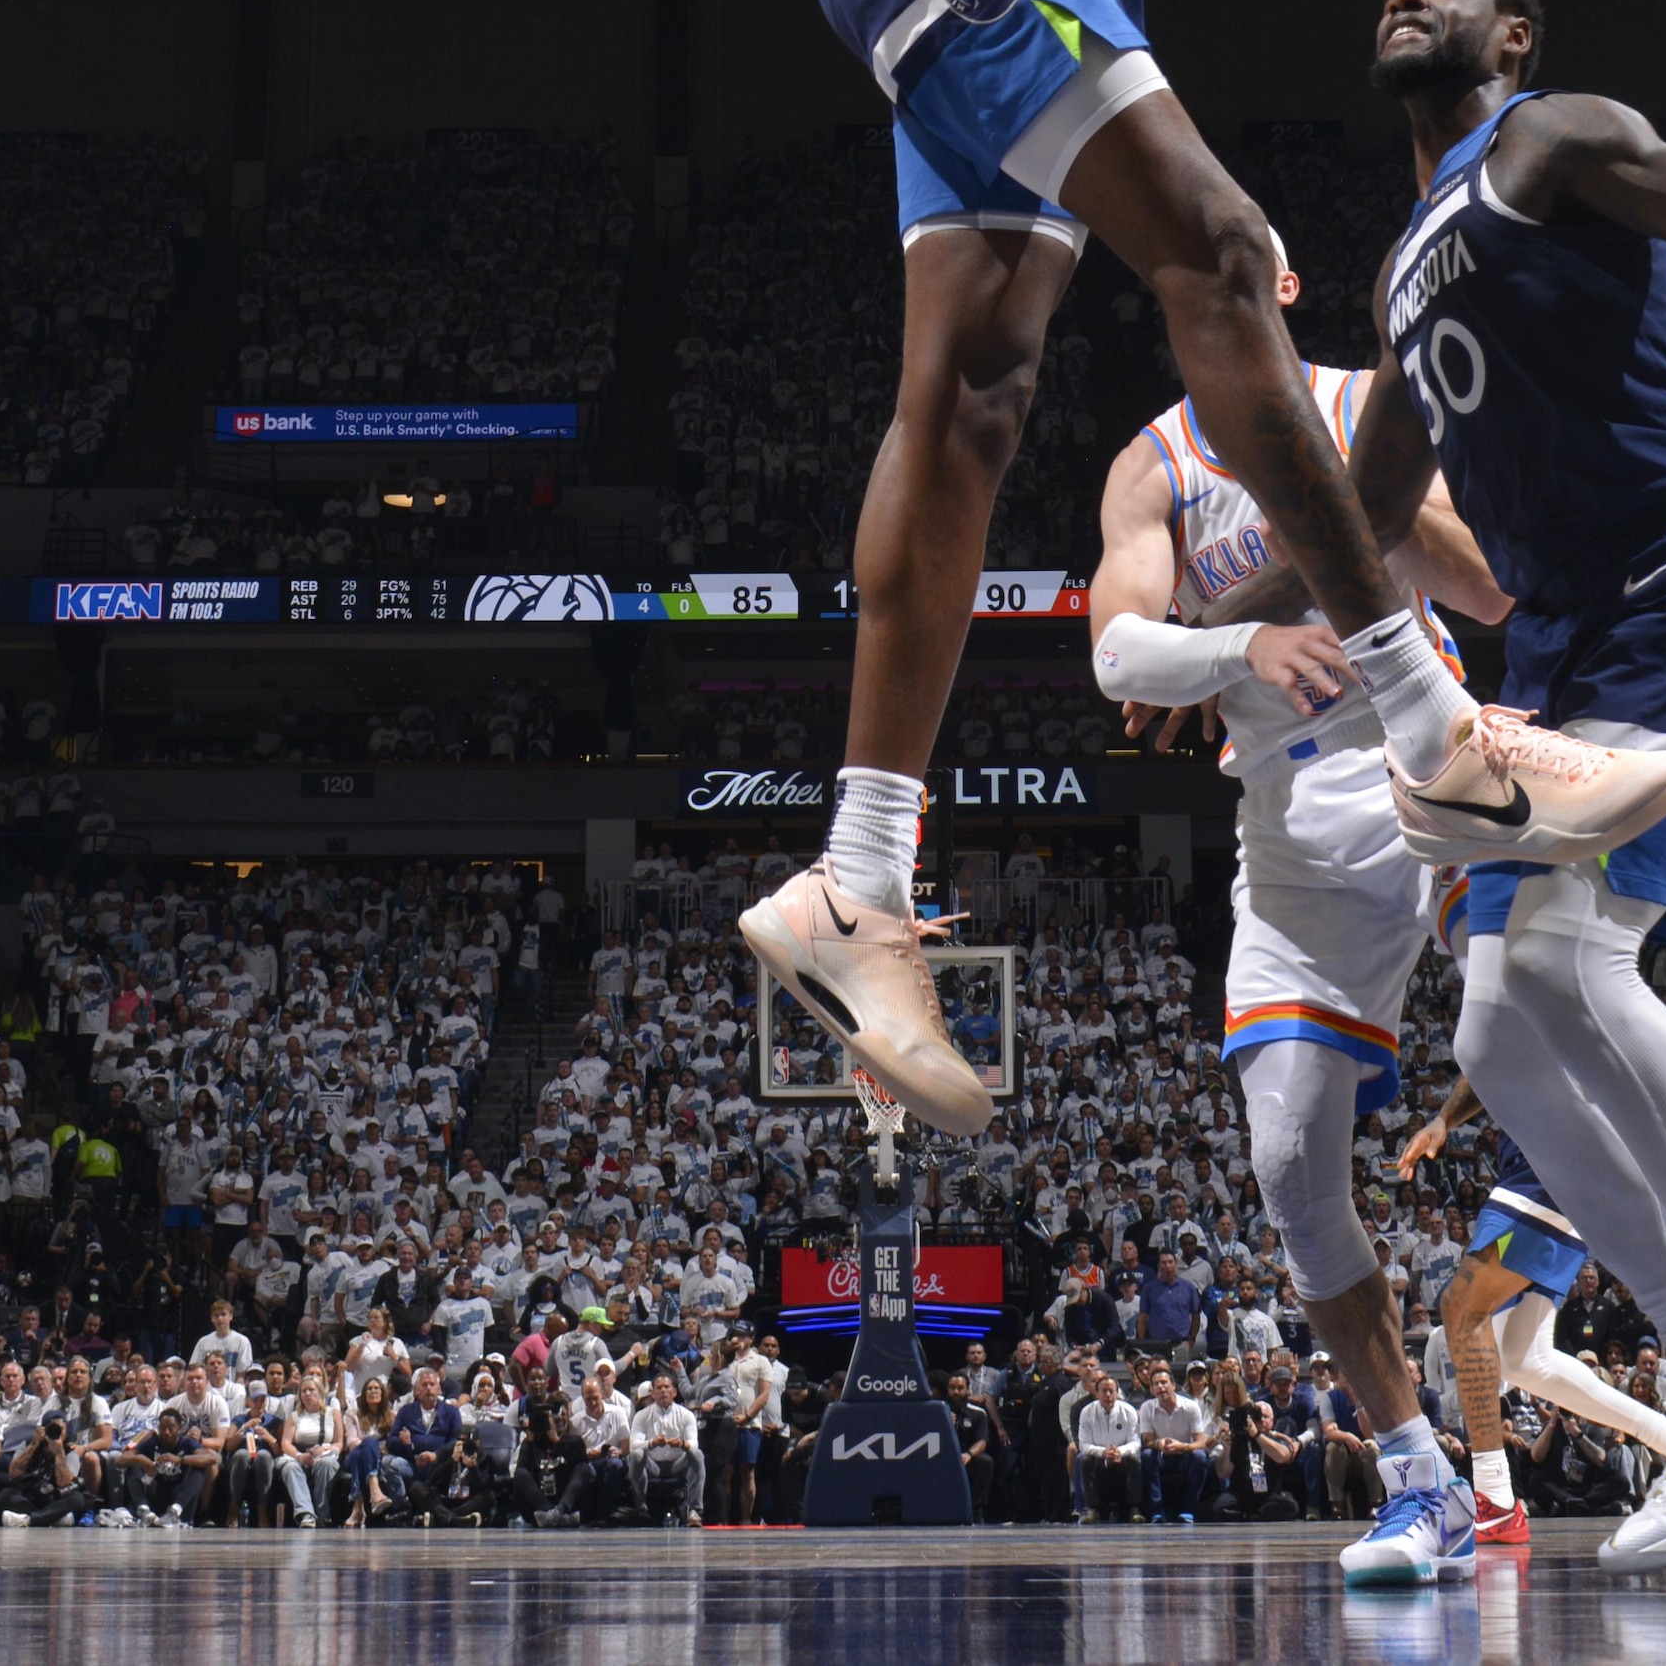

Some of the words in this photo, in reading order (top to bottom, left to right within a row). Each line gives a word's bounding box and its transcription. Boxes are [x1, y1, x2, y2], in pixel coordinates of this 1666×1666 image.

[1402, 318, 1486, 446] 30
[237, 416, 260, 430] us
[336, 410, 363, 423] Step
[368, 412, 382, 423] up
[384, 411, 413, 423] your
[415, 411, 450, 423] game
[453, 409, 479, 420] with
[336, 424, 360, 436] U.S.
[364, 424, 394, 436] Bank
[455, 424, 519, 438] Checking.
[171, 582, 220, 599] SPORTS
[222, 581, 260, 599] RADIO
[290, 580, 318, 592] REB
[341, 580, 357, 591] 29
[380, 580, 410, 592] FG%
[433, 580, 447, 591] 51
[636, 583, 652, 592] TO
[672, 582, 692, 592] FLS
[1065, 579, 1086, 589] FLS
[55, 583, 162, 620] KFAN
[290, 594, 316, 606] AST
[341, 594, 356, 605] 20
[380, 593, 409, 604] FT%
[432, 593, 447, 605] 75
[732, 586, 772, 614] 85
[986, 583, 1026, 611] 90
[1070, 595, 1079, 610] 0
[170, 603, 188, 619] FM
[189, 603, 224, 619] 100.3
[290, 608, 316, 620] STL
[376, 608, 412, 619] 3PT%
[431, 607, 446, 619] 42
[638, 599, 649, 614] 4
[680, 600, 689, 614] 0
[321, 776, 353, 793] 120
[875, 1247, 899, 1268] GET
[875, 1271, 900, 1291] THE
[881, 1295, 906, 1321] App
[1288, 1325, 1297, 1338] 3
[570, 1361, 585, 1384] 5
[857, 1375, 917, 1396] Google
[833, 1433, 940, 1460] KIA
